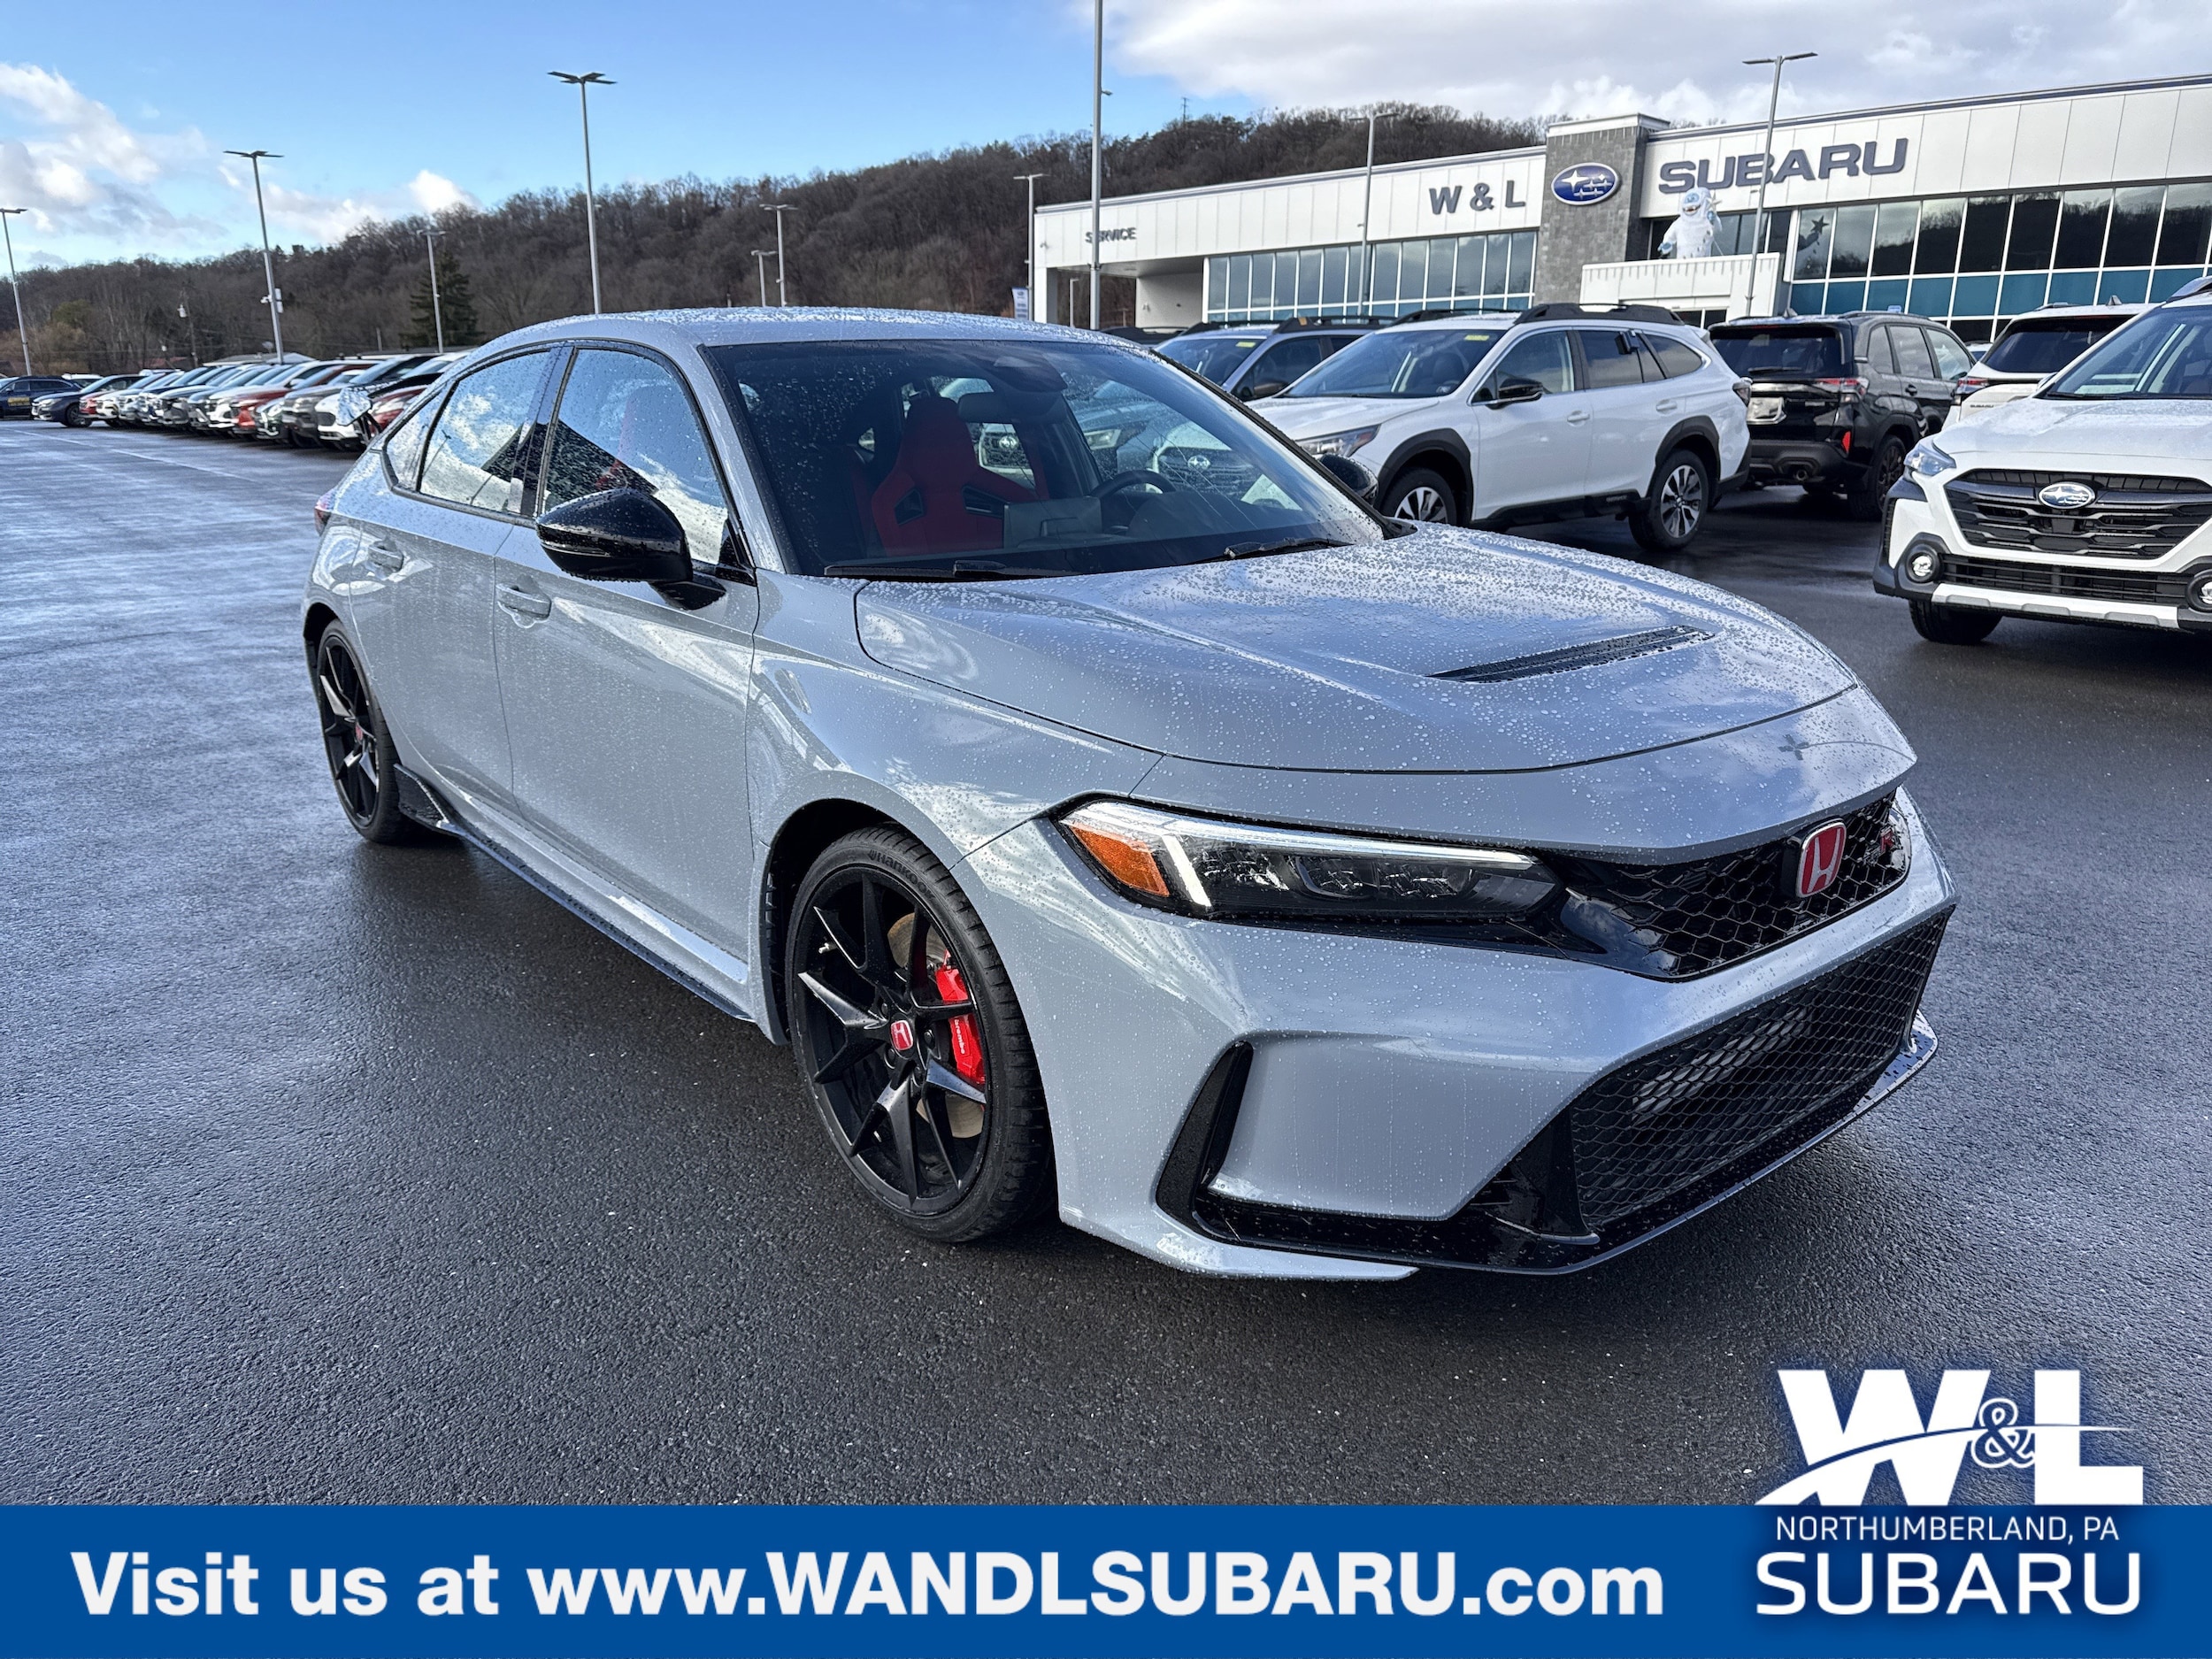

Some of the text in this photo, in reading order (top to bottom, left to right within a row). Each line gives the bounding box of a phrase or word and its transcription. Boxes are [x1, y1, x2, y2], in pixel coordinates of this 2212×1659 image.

[1659, 137, 1909, 194] SUBARU
[1429, 180, 1526, 215] W & L
[1085, 227, 1137, 244] SRVICE
